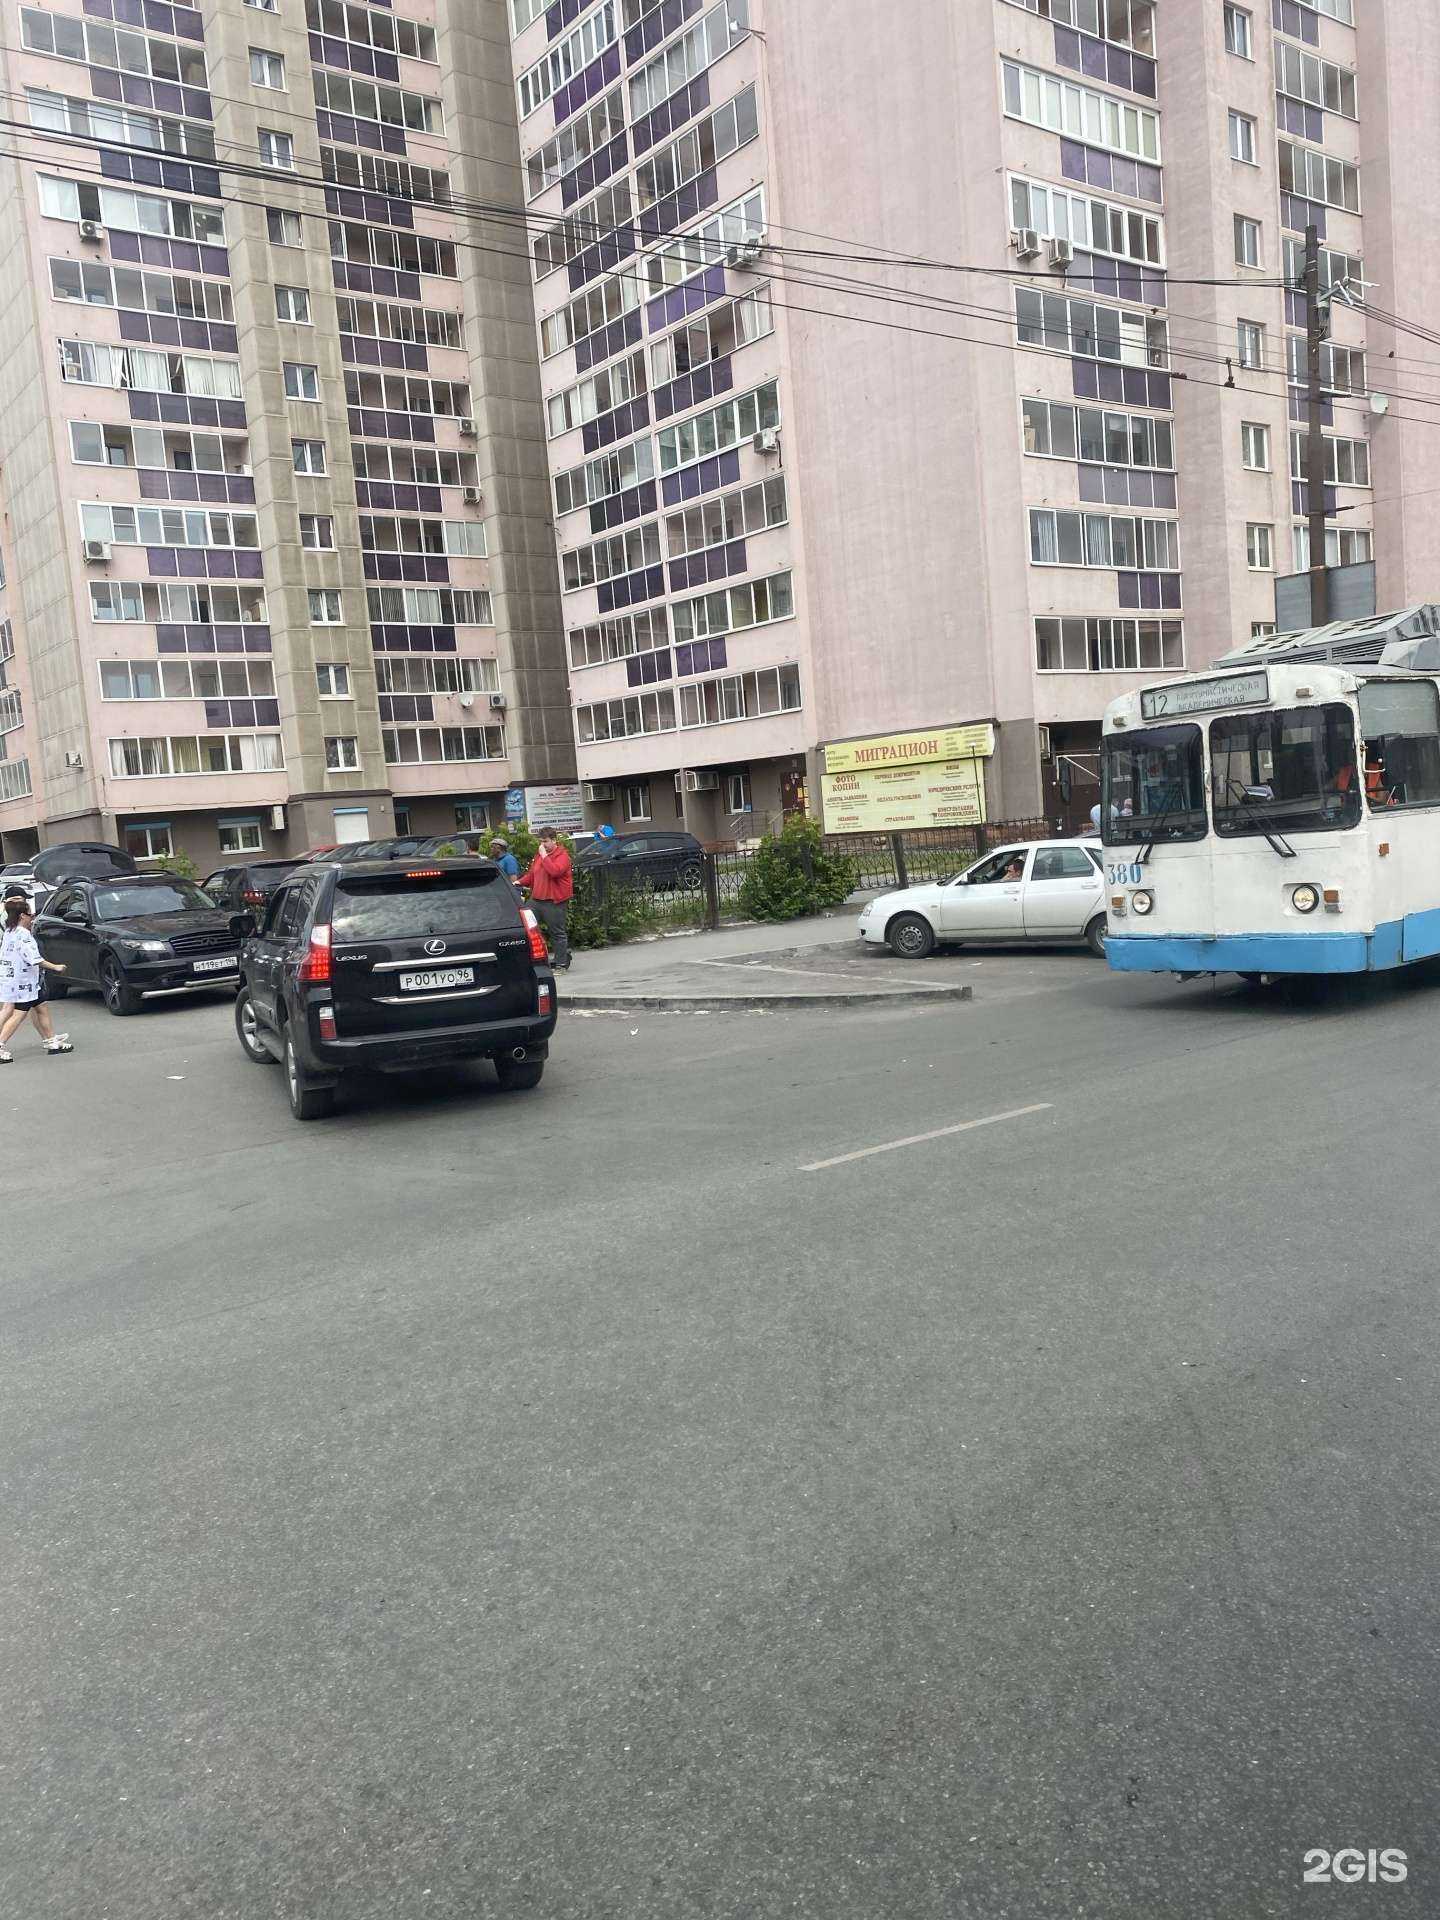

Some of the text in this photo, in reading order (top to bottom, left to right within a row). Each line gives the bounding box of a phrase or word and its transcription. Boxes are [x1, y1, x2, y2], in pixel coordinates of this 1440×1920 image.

[1151, 694, 1168, 717] 12
[854, 740, 939, 764] МИГРАЦИОН
[832, 782, 861, 792] КОПИИ
[835, 774, 856, 783] ФОТО
[1104, 863, 1142, 885] 380
